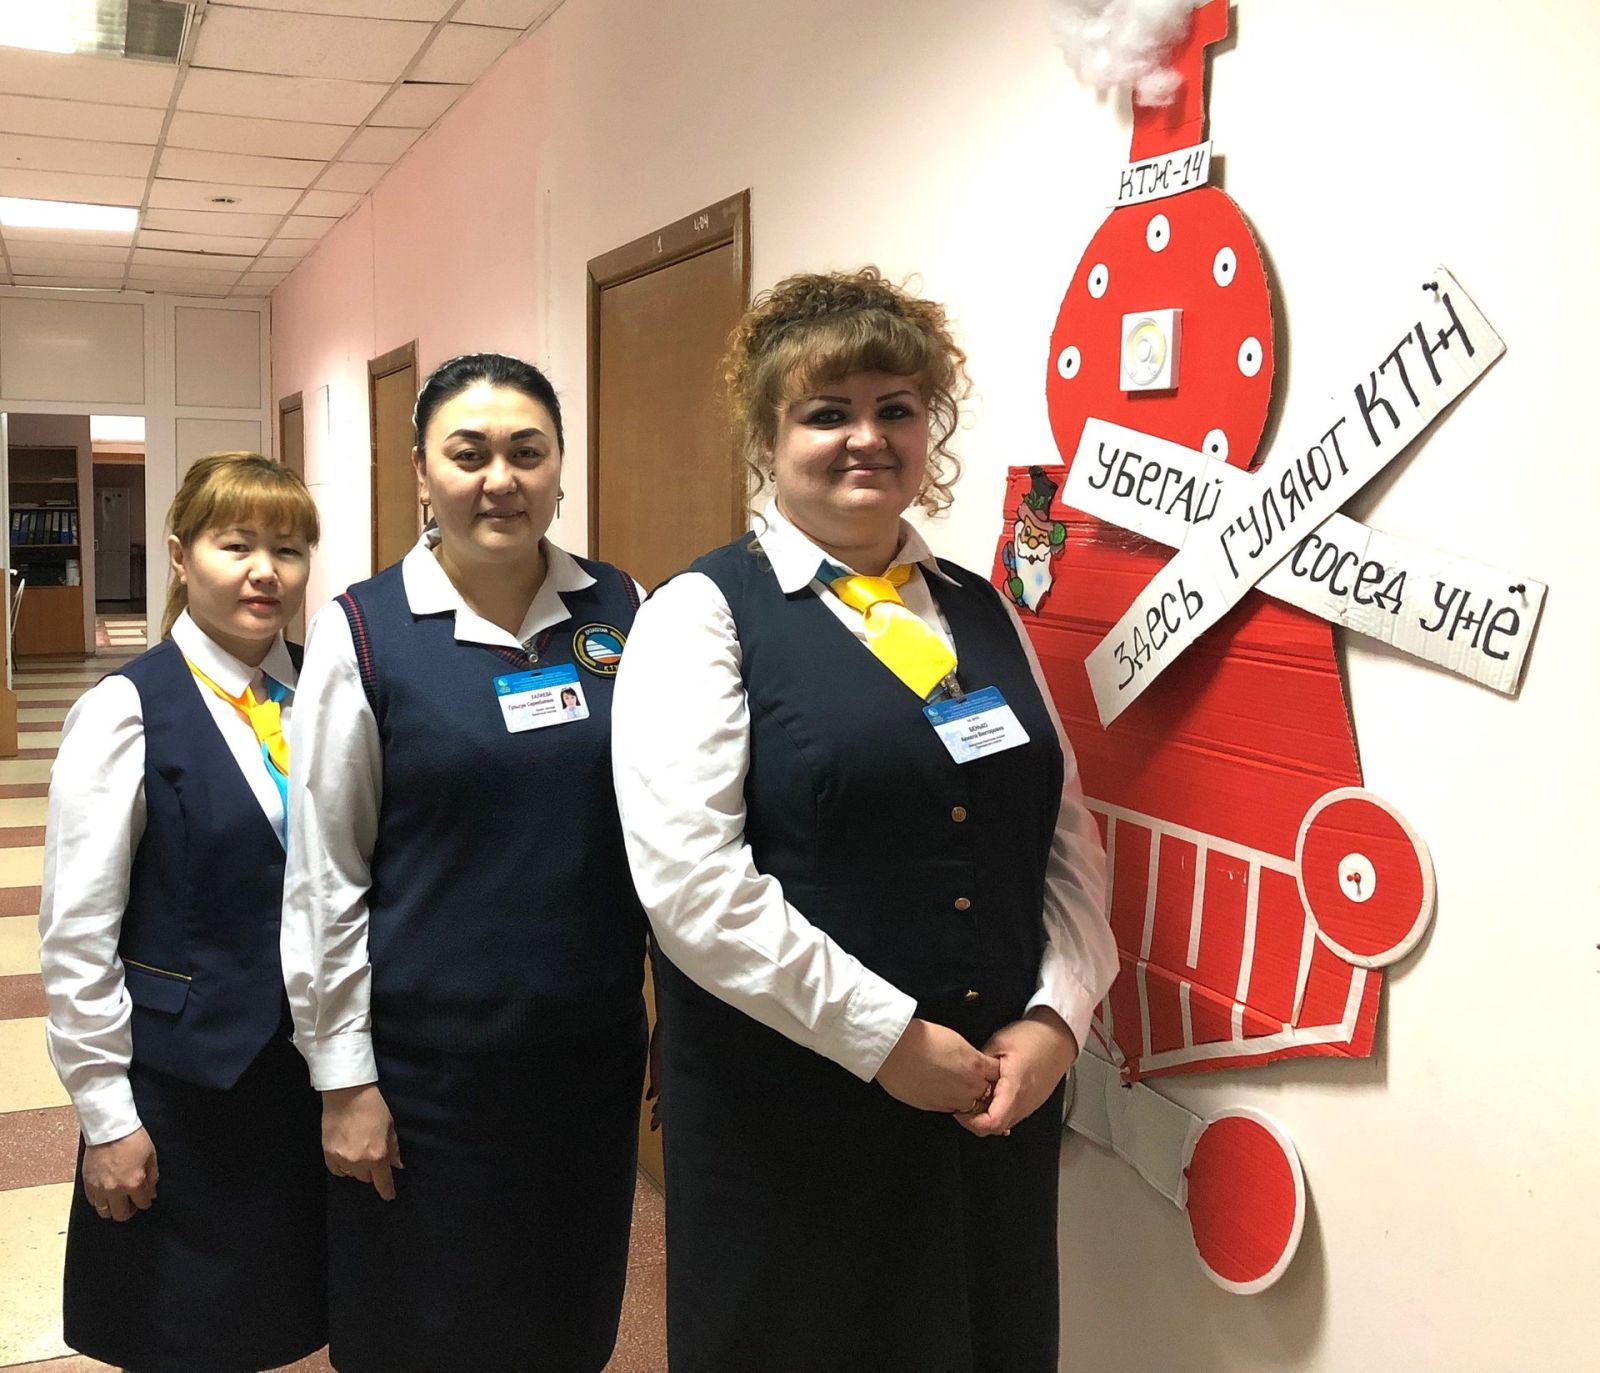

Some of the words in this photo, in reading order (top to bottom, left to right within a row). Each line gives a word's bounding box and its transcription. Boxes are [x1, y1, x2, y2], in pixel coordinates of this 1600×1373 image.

[1118, 150, 1205, 200] КТЖ-14
[1088, 442, 1223, 524] УБЕГАЙ
[1291, 534, 1407, 614] СОСЕД
[1419, 581, 1520, 660] УЖЕ
[1114, 578, 1204, 690] ЗДЕСЬ
[1220, 416, 1349, 579] ГУЛЯЮТ
[1354, 292, 1475, 447] КТЖ
